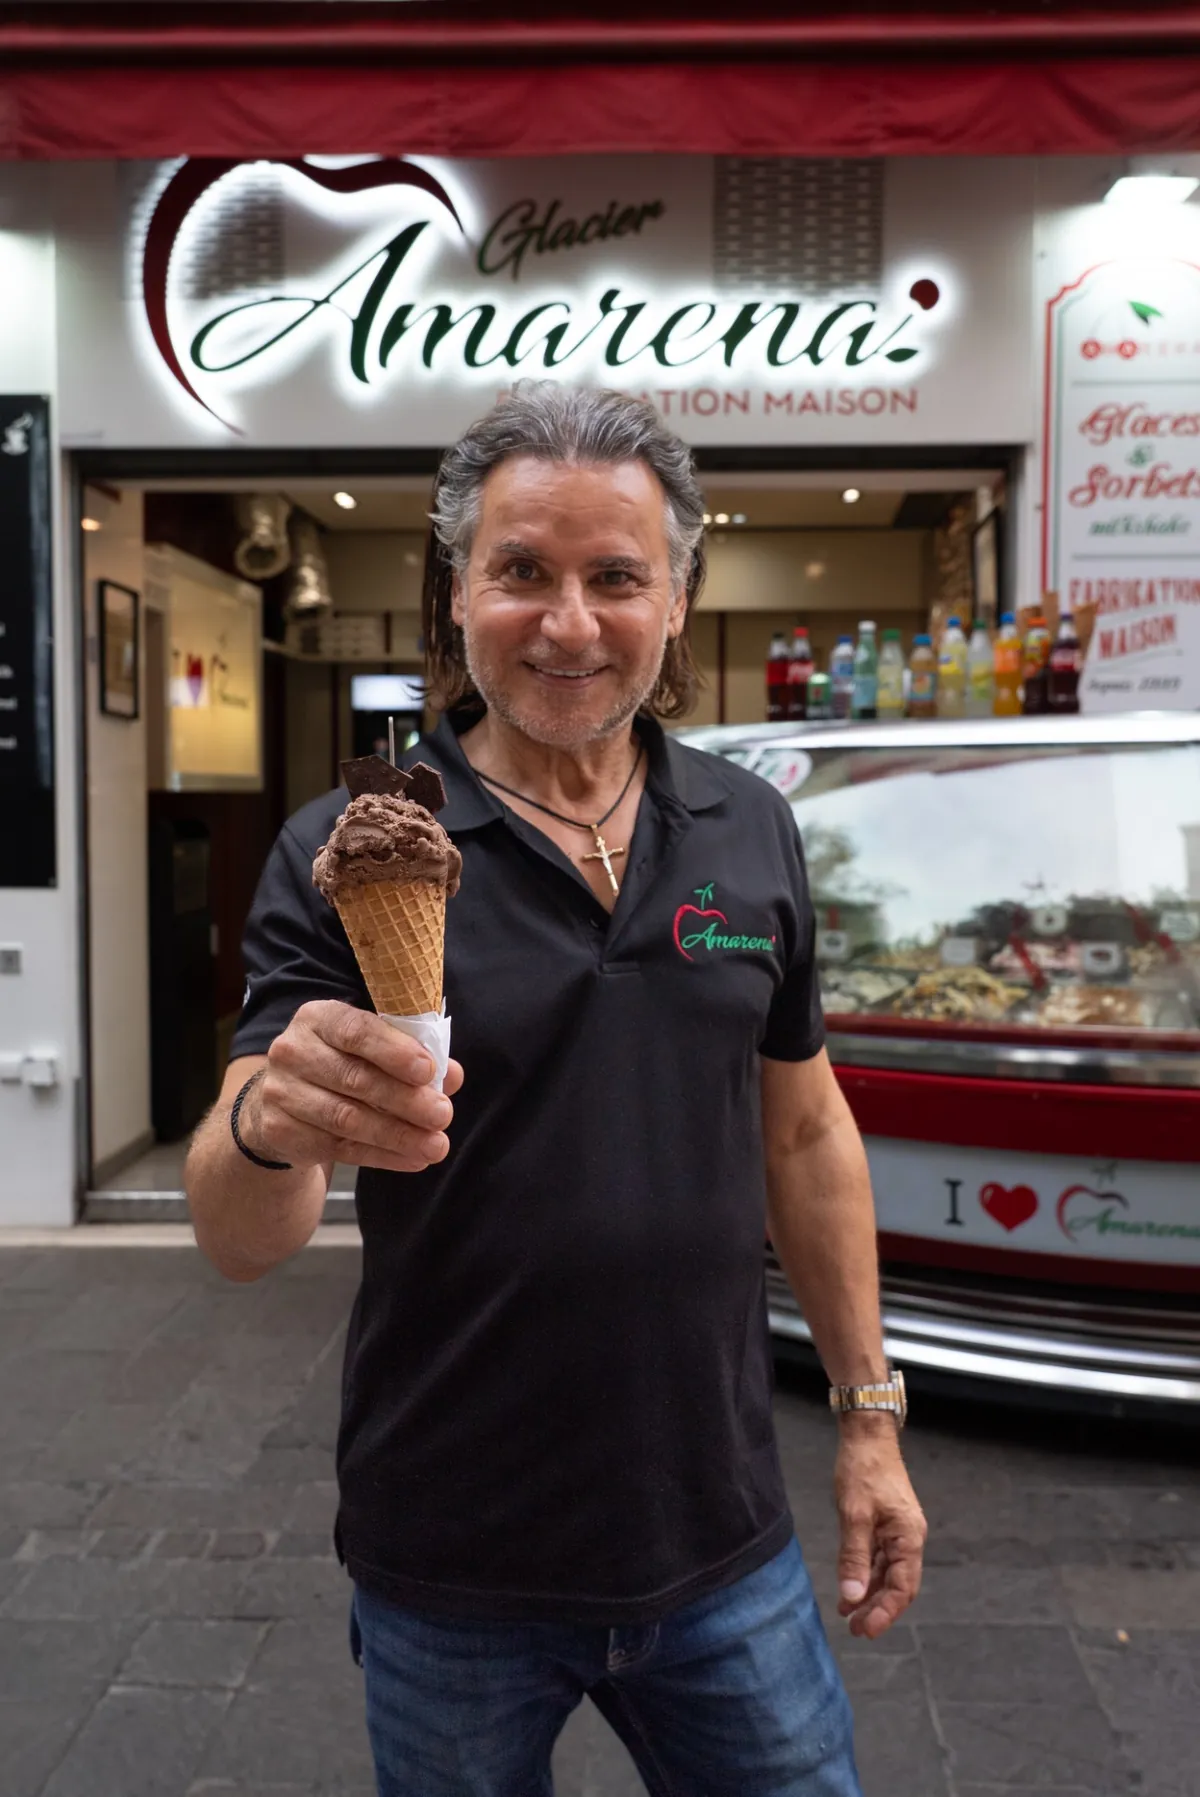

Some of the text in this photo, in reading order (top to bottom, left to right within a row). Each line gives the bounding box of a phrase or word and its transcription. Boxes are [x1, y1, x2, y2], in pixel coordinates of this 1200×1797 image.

[477, 198, 666, 283] Glacier
[190, 220, 888, 384] Amarena
[765, 387, 918, 416] MAISON
[1098, 614, 1176, 660] MAISON
[944, 1178, 964, 1226] I
